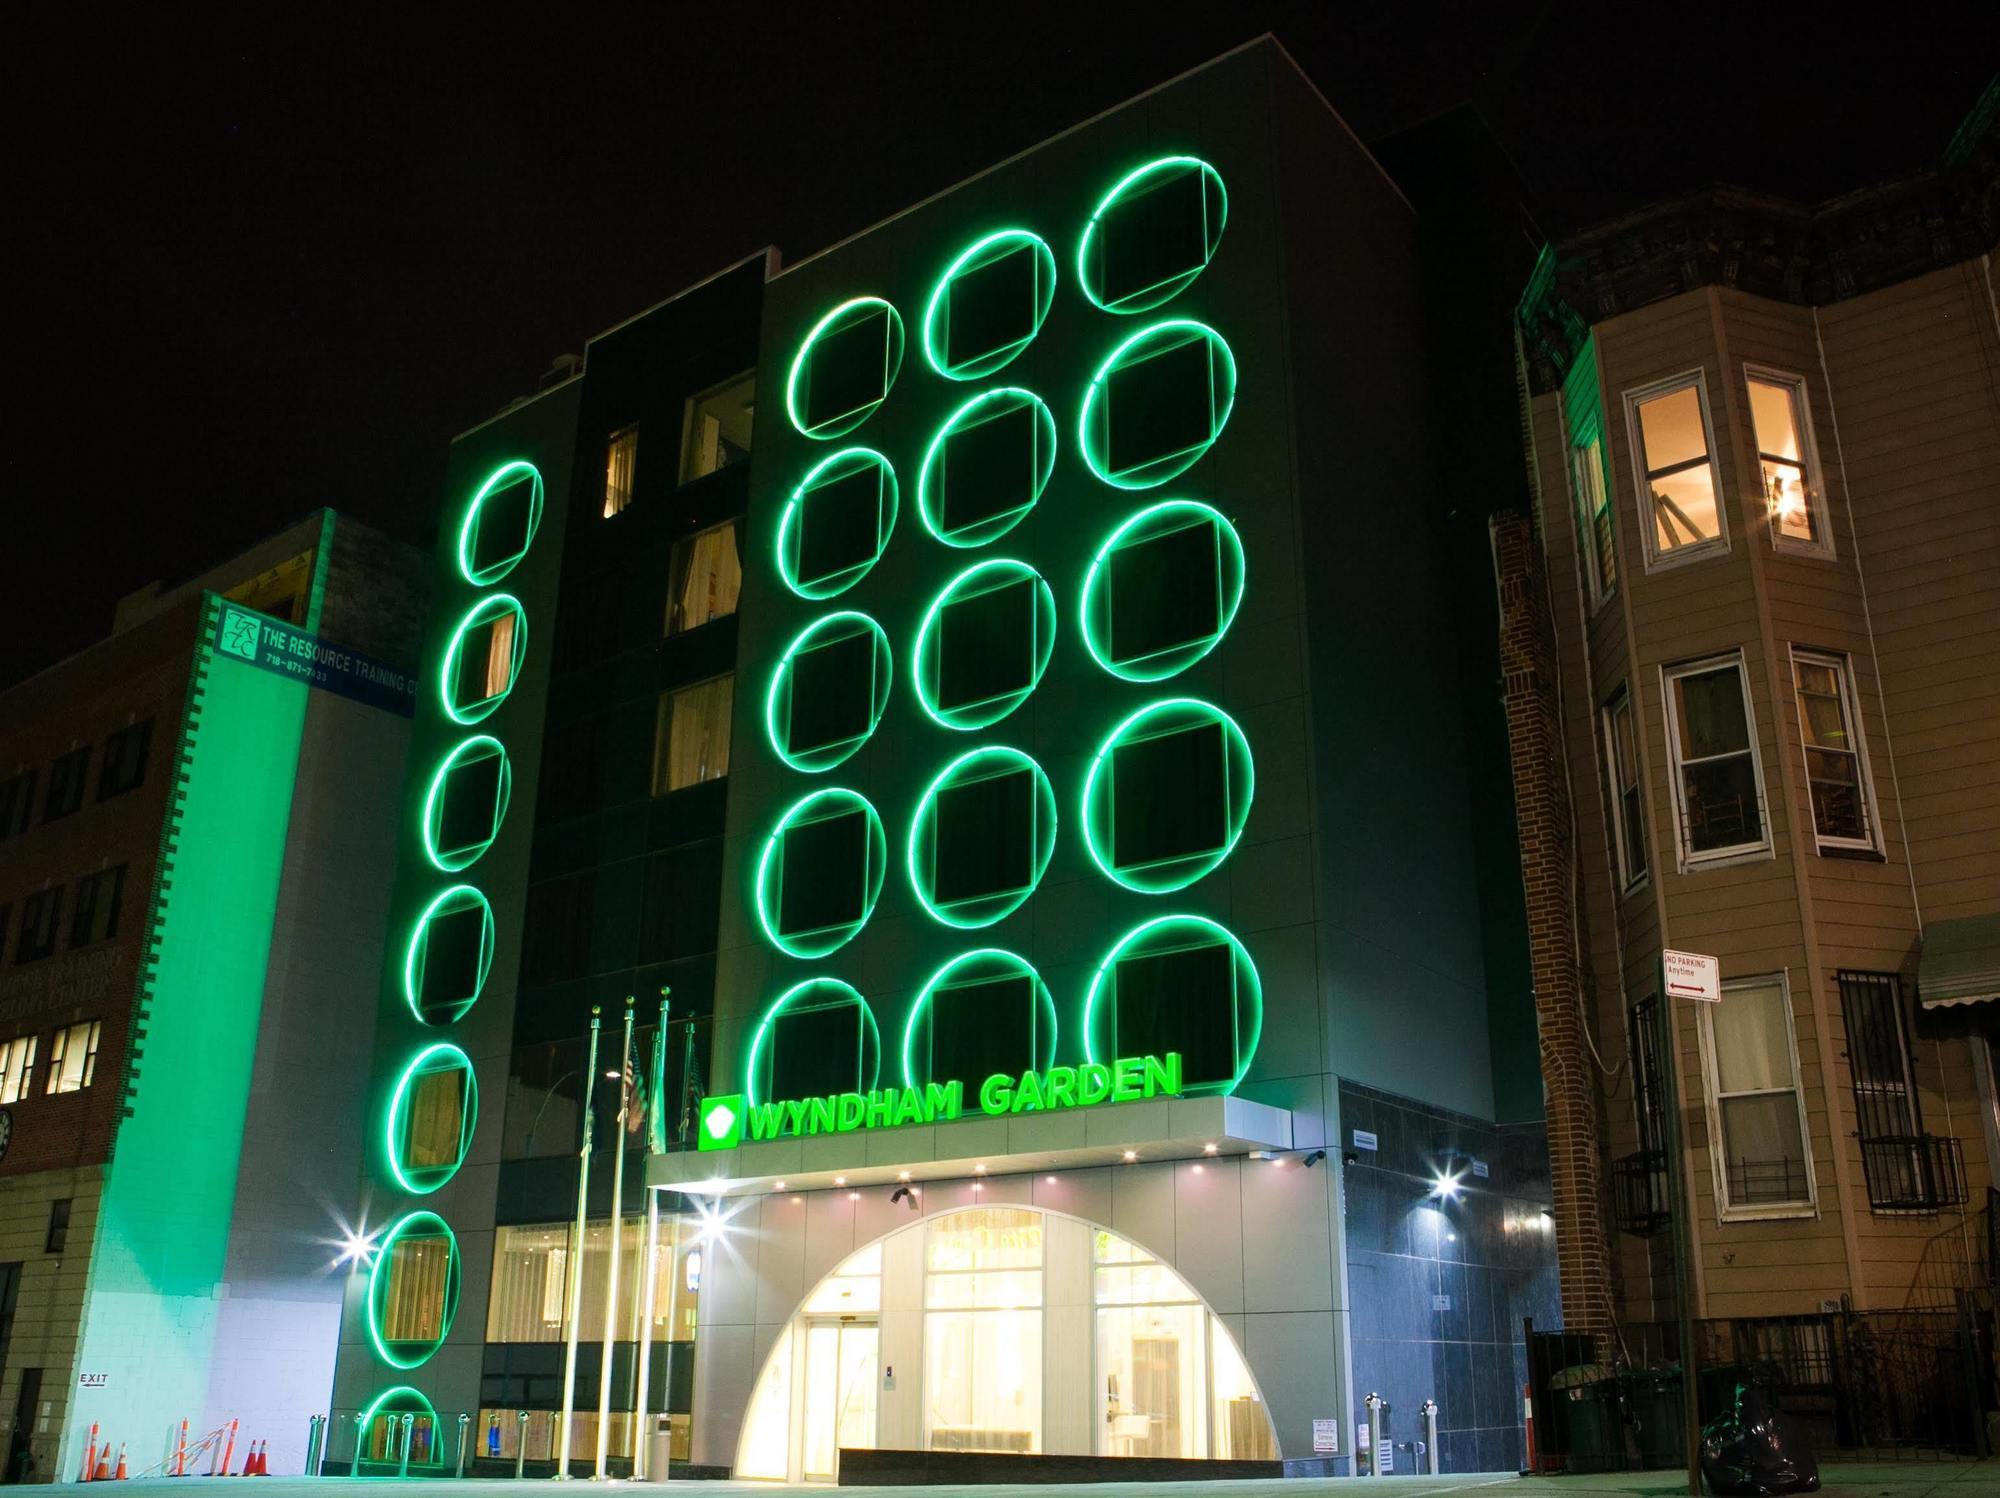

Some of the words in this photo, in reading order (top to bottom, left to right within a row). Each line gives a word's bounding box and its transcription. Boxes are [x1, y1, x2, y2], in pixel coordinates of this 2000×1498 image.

[263, 626, 285, 650] THE
[289, 636, 351, 673] RESOURCE
[355, 659, 404, 691] TRAINING
[1667, 956, 1676, 964] NO
[1678, 957, 1705, 968] PARKING
[1668, 966, 1694, 976] Anytime
[749, 1080, 963, 1140] WYNDHAM
[981, 1052, 1182, 1115] GARDEN
[80, 1374, 108, 1382] EXIT
